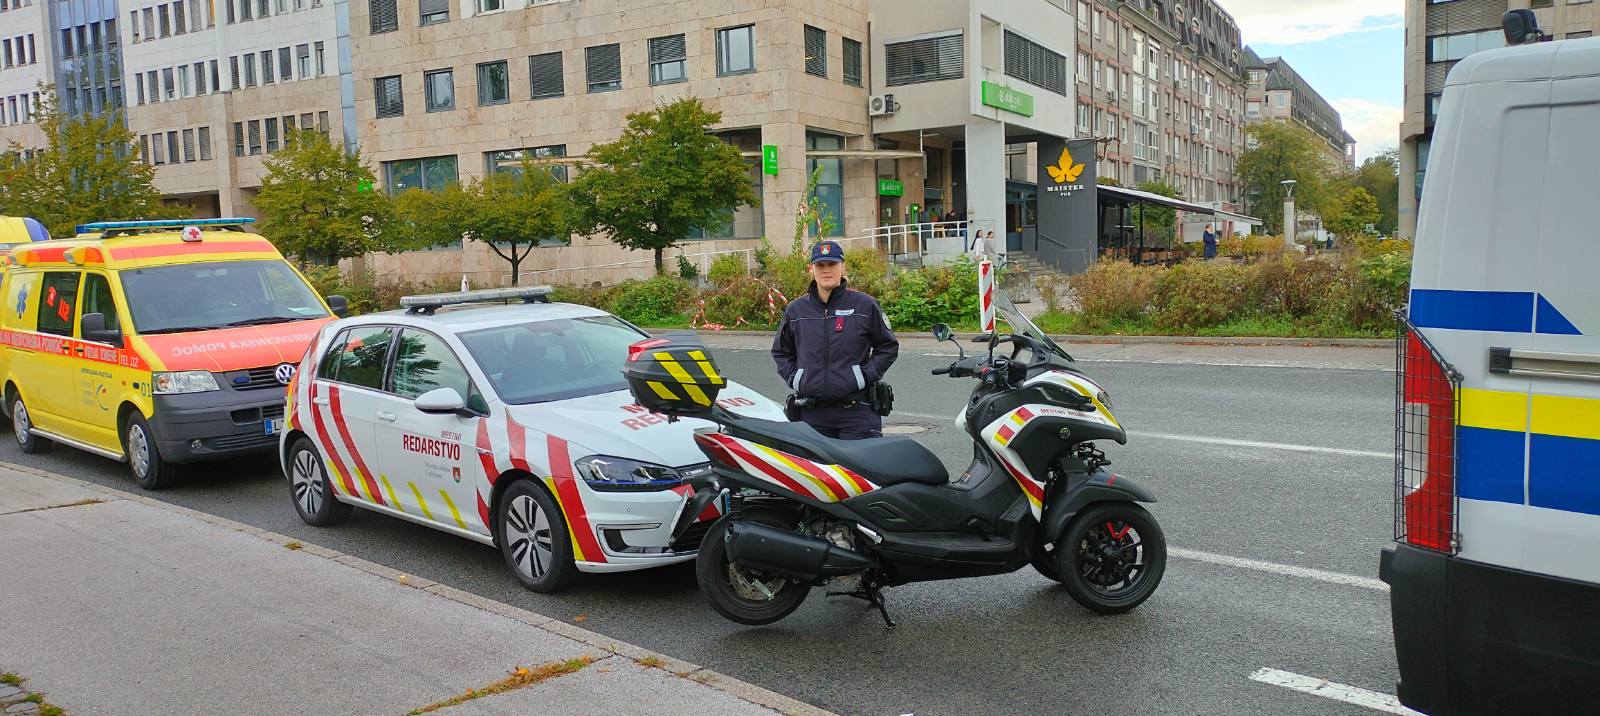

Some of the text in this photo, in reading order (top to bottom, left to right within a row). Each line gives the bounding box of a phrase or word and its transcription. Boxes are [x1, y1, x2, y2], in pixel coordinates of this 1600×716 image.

[1046, 184, 1084, 192] MAISTER
[140, 382, 151, 397] 01
[441, 430, 461, 441] MESTNO
[403, 434, 460, 461] REDARSTVO
